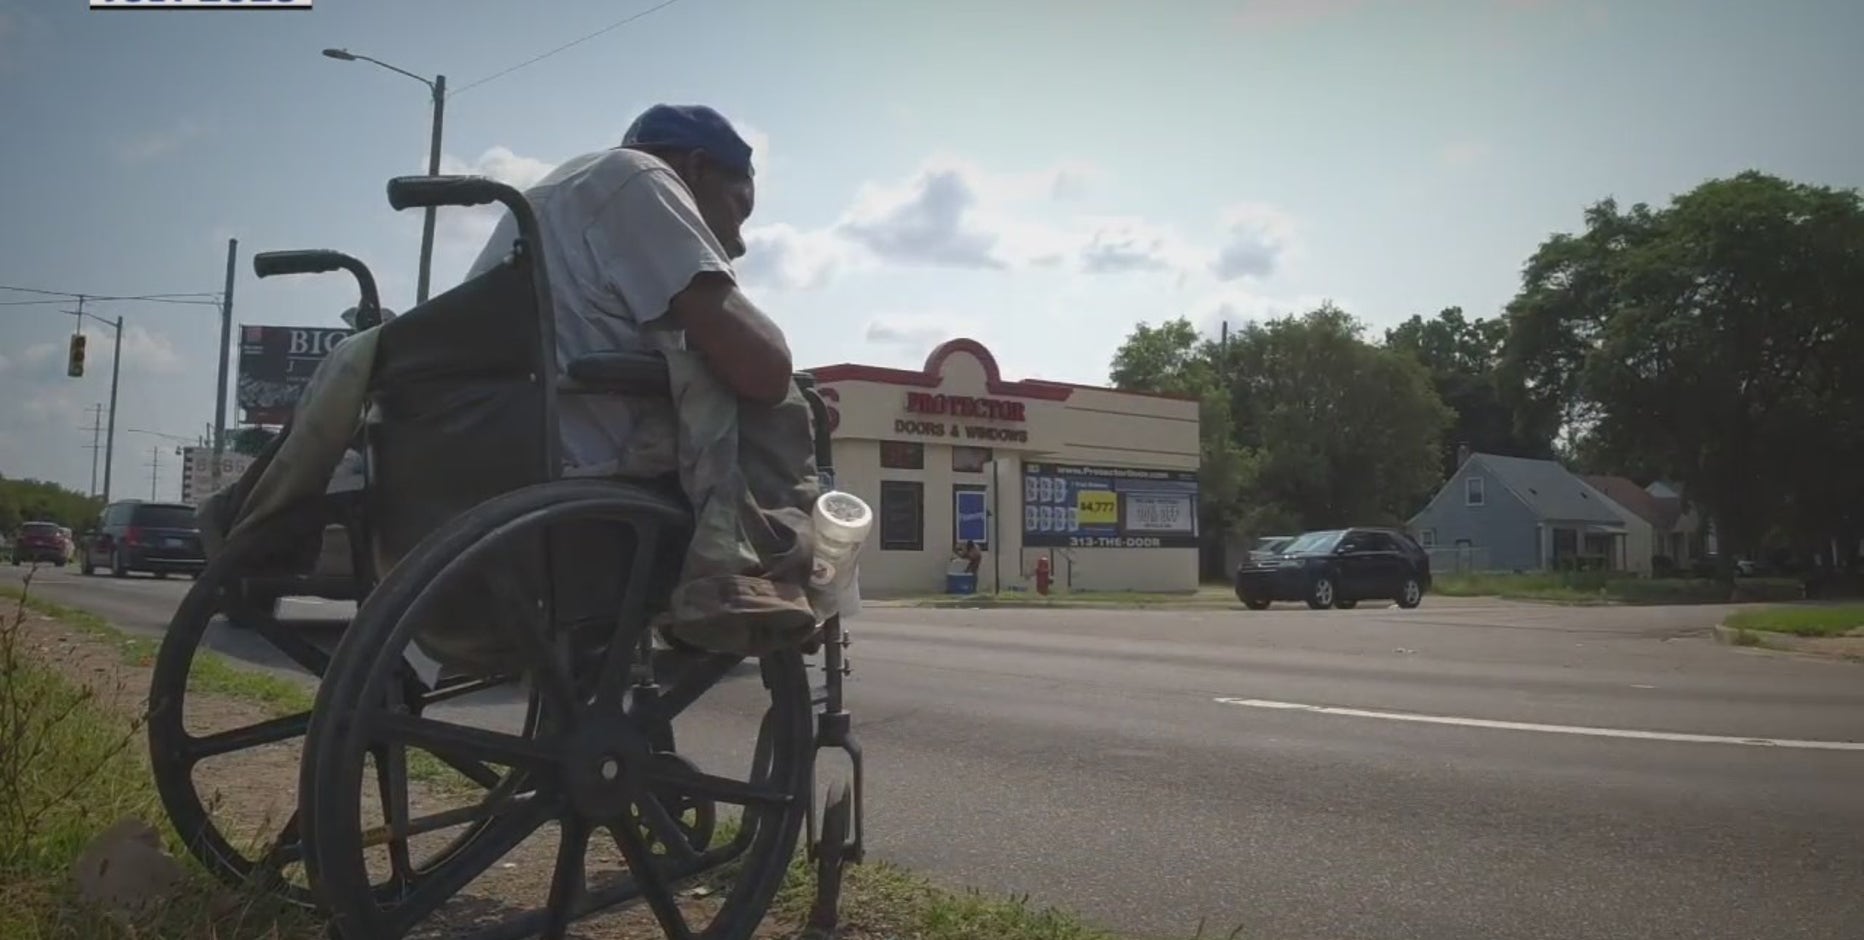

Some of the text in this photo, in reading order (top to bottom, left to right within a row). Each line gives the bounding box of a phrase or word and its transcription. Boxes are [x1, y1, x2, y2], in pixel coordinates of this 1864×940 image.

[907, 392, 1026, 422] PROTECTOR
[895, 419, 1028, 443] DOORS & WINDOWS
[1069, 536, 1161, 547] 313-THE-DOOR
